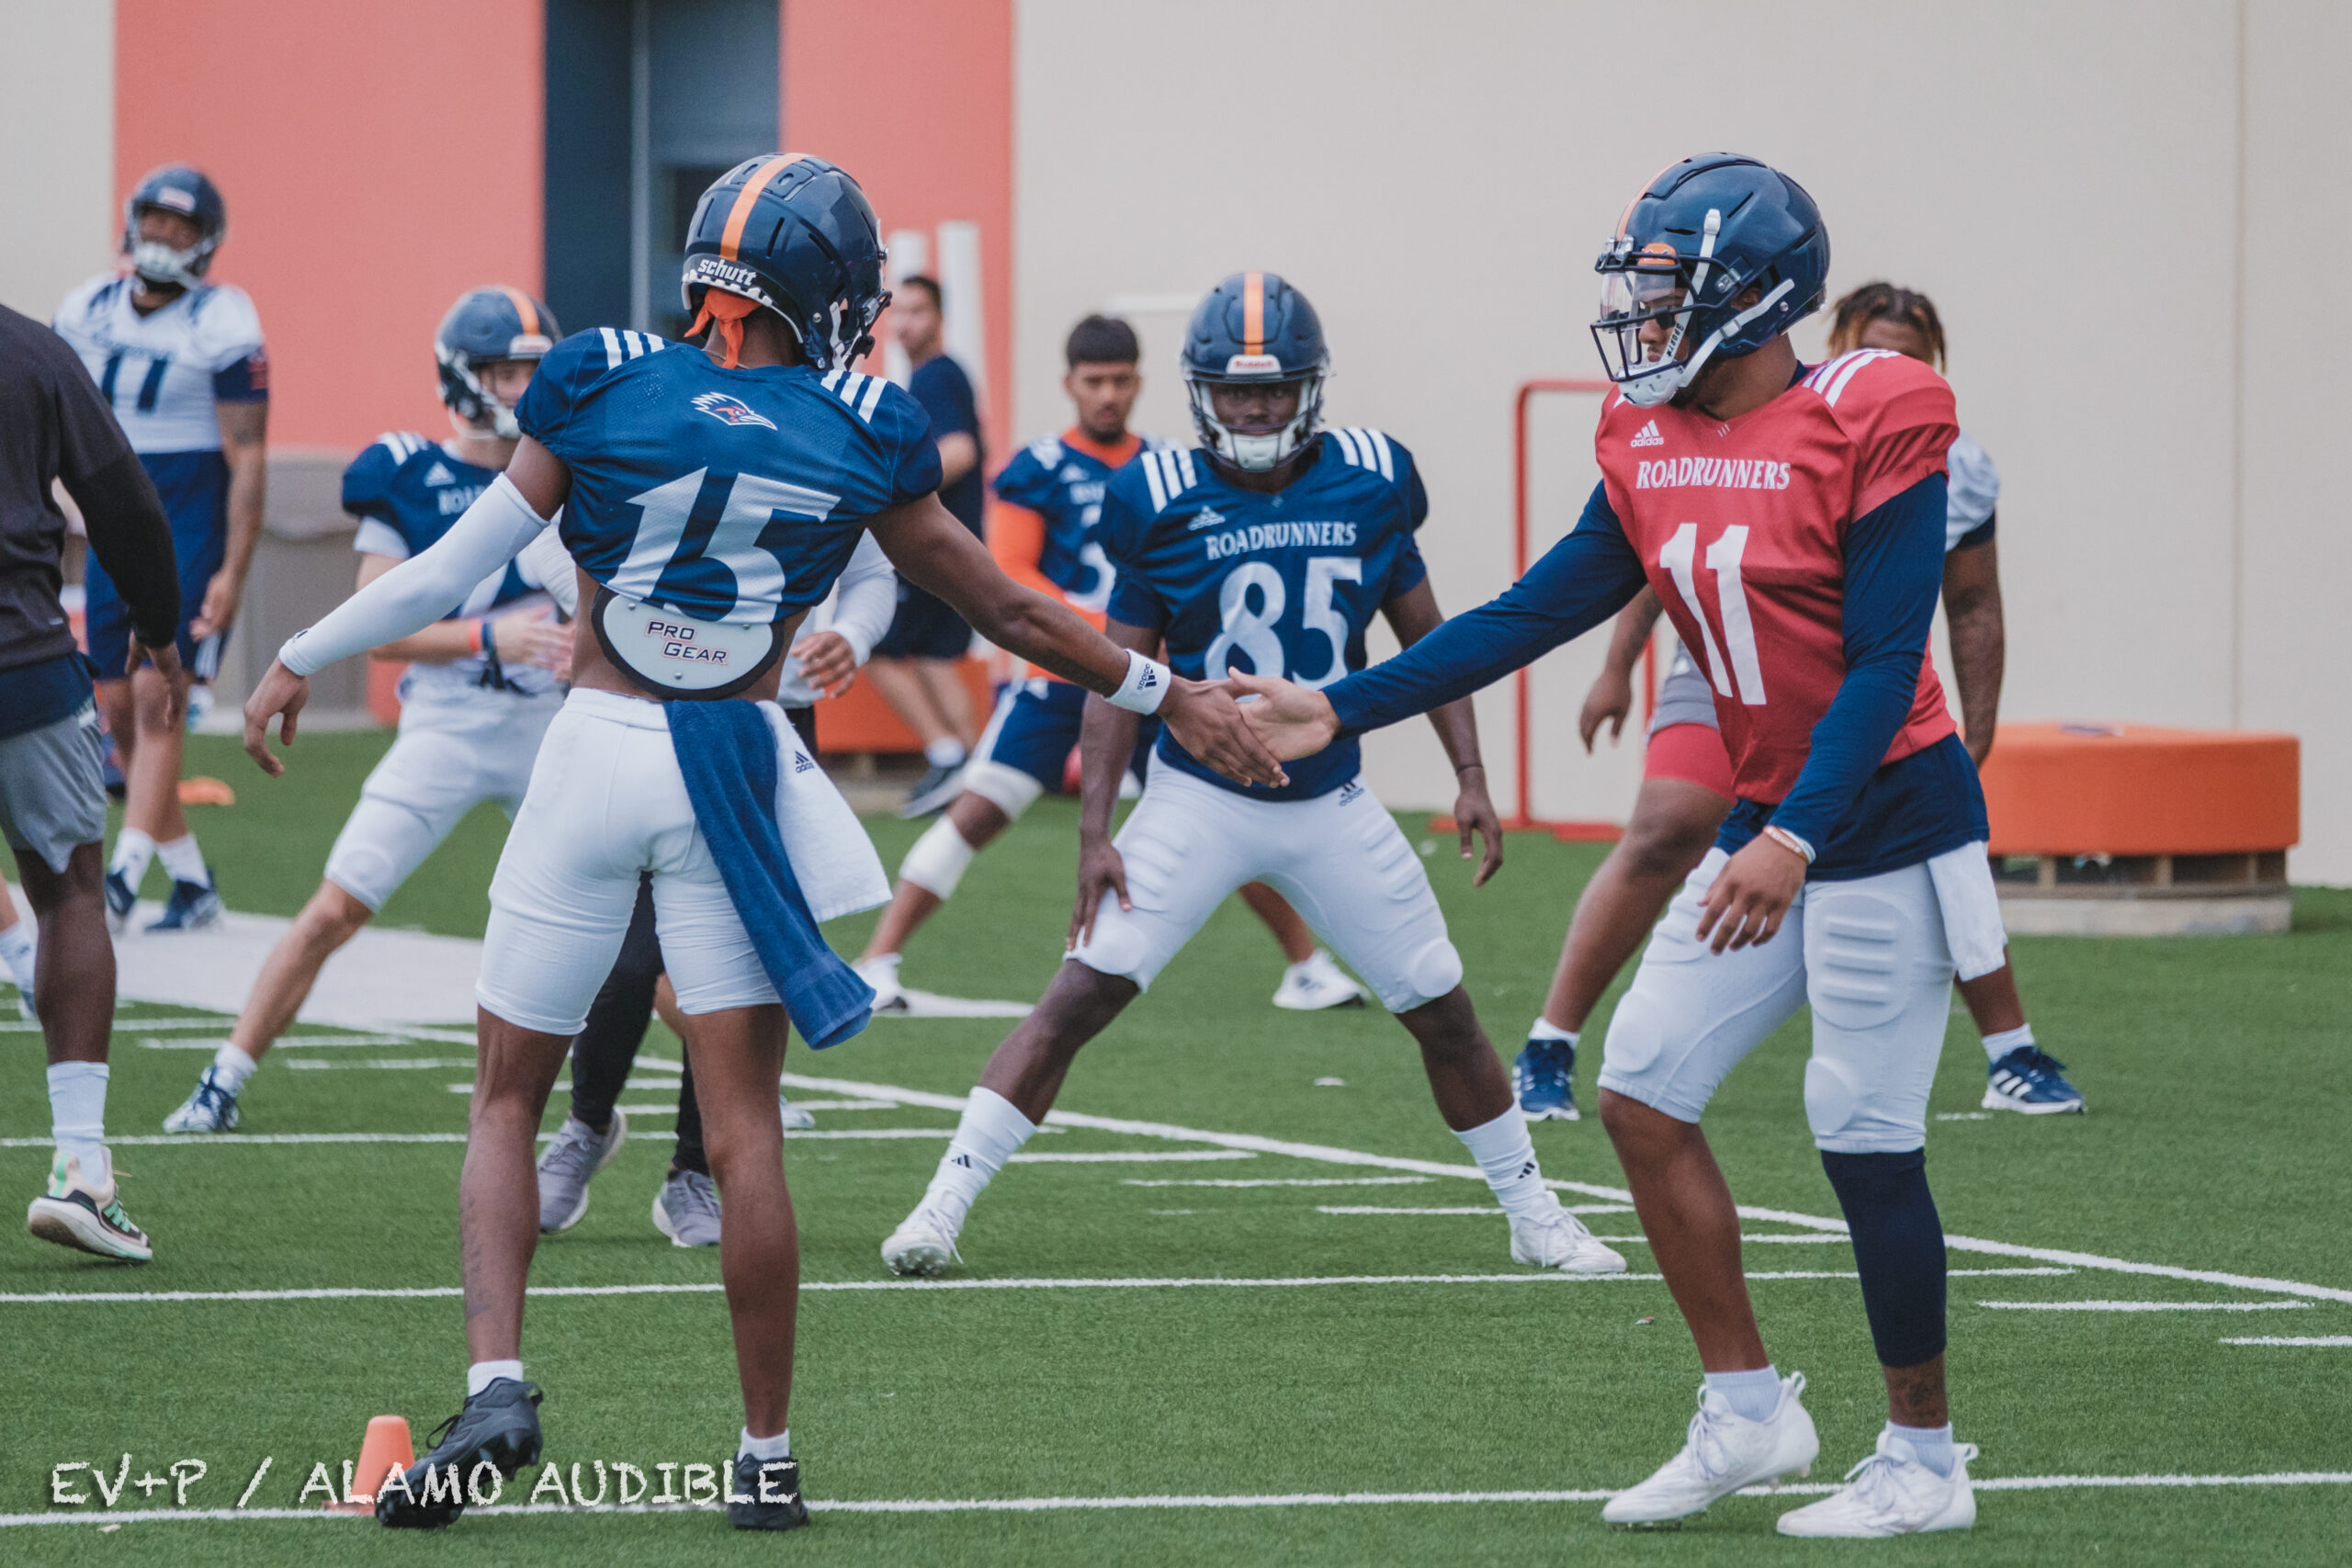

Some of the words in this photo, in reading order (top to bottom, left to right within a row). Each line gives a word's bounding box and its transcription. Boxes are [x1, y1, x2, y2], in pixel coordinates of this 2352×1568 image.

[698, 258, 757, 286] schutt
[1630, 436, 1665, 447] adidas
[1635, 457, 1792, 490] ROADRUNNERS
[600, 466, 842, 624] 15
[1204, 521, 1358, 560] ROADRUNNERS
[646, 619, 695, 641] PRO
[1204, 557, 1363, 694] 85
[1659, 522, 1768, 705] 11
[662, 641, 728, 664] GEAR
